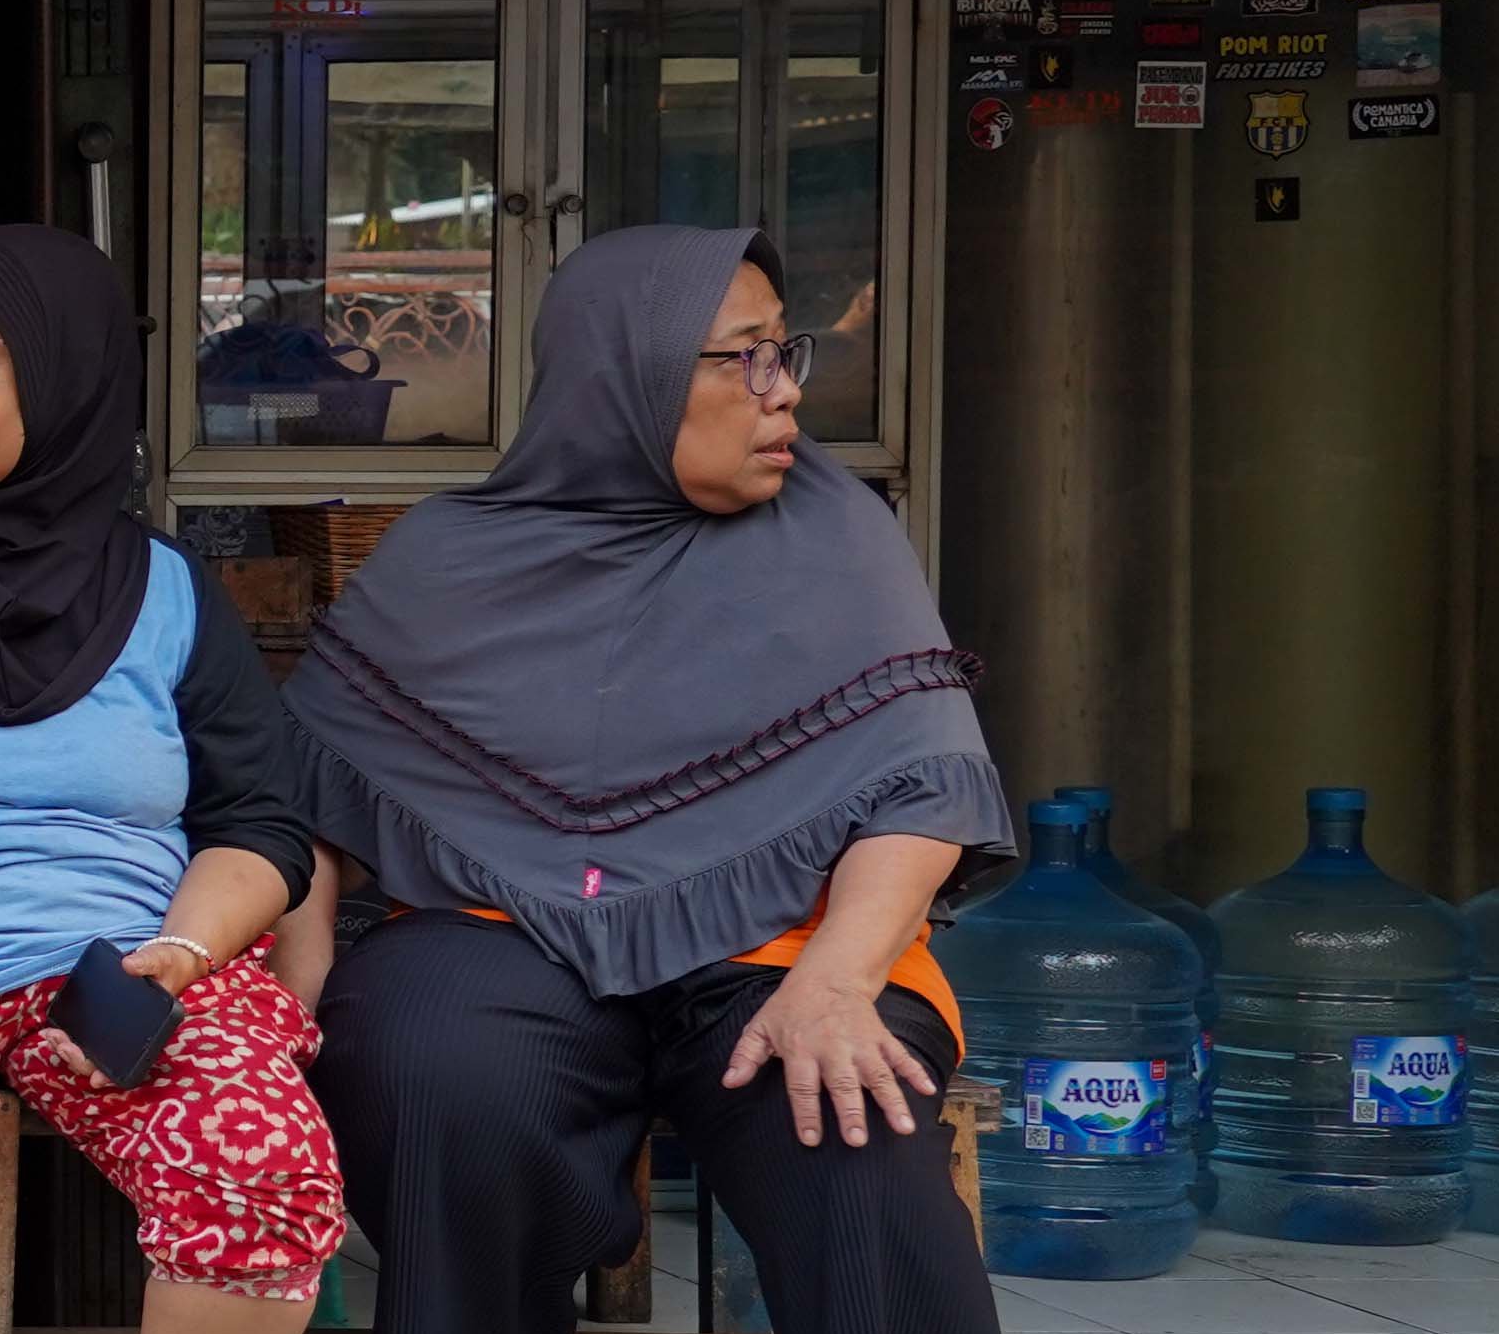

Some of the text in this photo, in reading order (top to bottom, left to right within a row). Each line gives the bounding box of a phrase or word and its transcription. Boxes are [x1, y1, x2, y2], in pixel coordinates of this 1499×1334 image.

[1219, 33, 1328, 57] POM RIOT
[1363, 102, 1425, 118] ROMANTICA
[1387, 1051, 1451, 1081] AQUA
[1061, 1077, 1142, 1108] AQUA
